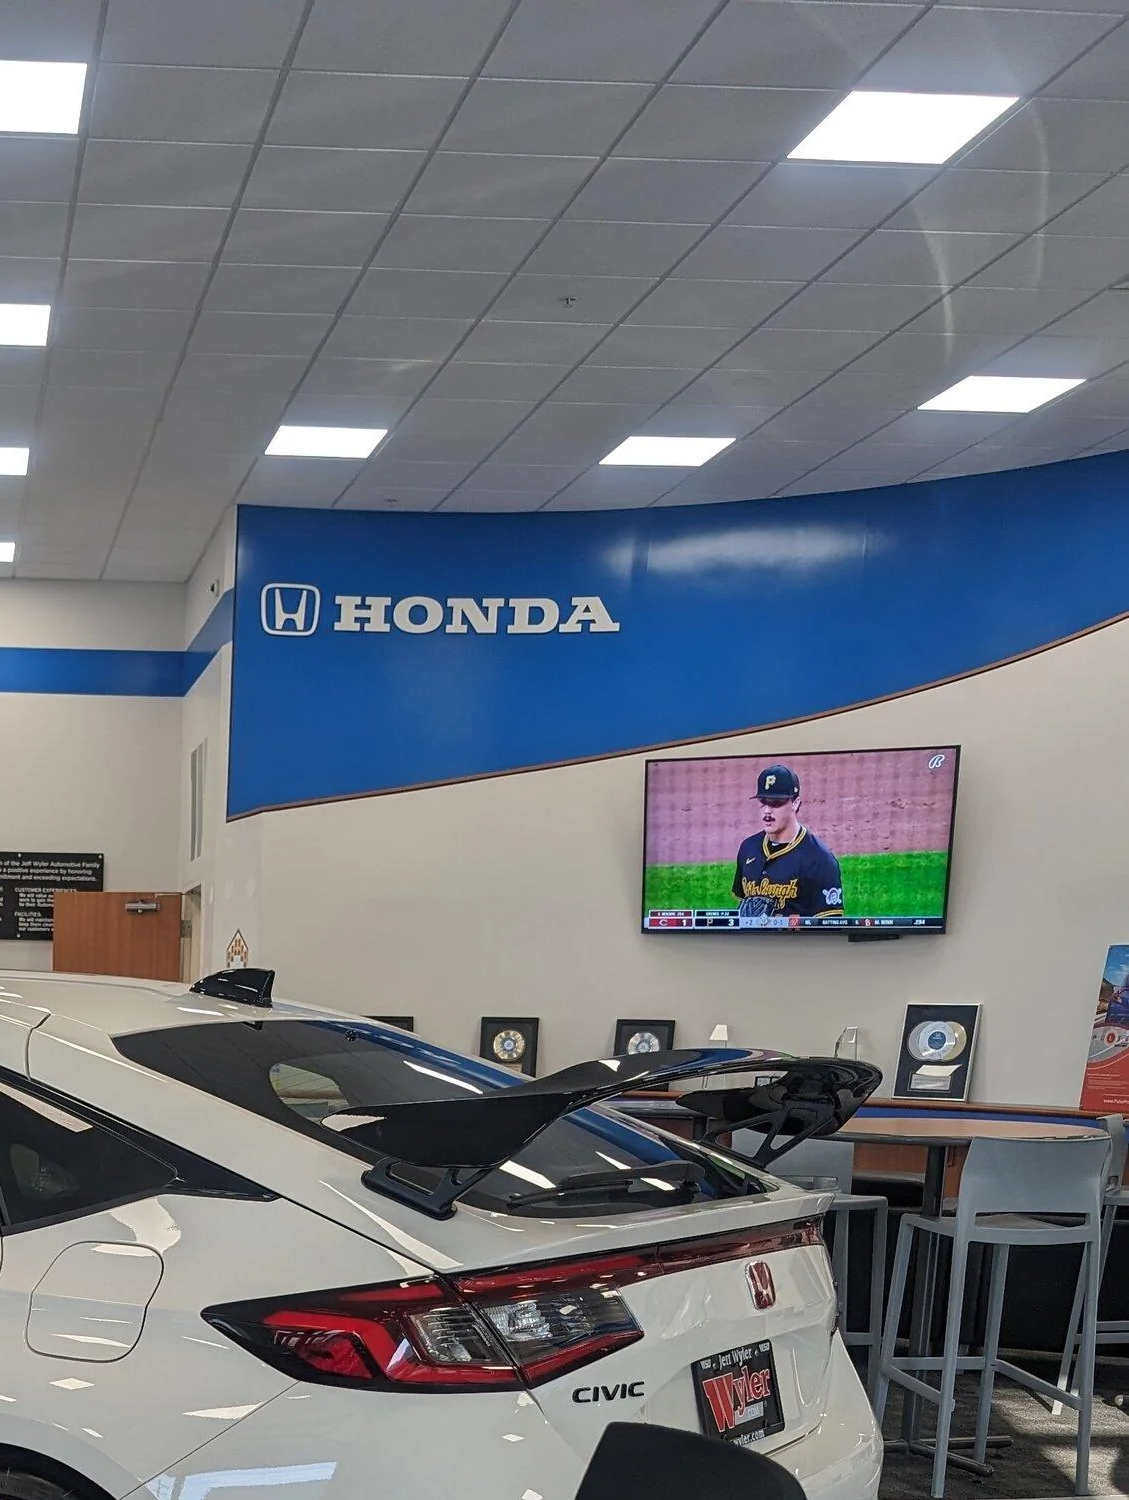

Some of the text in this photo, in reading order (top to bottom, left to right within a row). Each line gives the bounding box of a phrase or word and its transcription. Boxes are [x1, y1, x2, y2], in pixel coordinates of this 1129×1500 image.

[334, 596, 620, 634] HONDA
[731, 1347, 752, 1366] Wyler
[571, 1381, 645, 1403] CIVIC
[702, 1365, 770, 1432] Wyler
[732, 1429, 765, 1446] wyler.com
